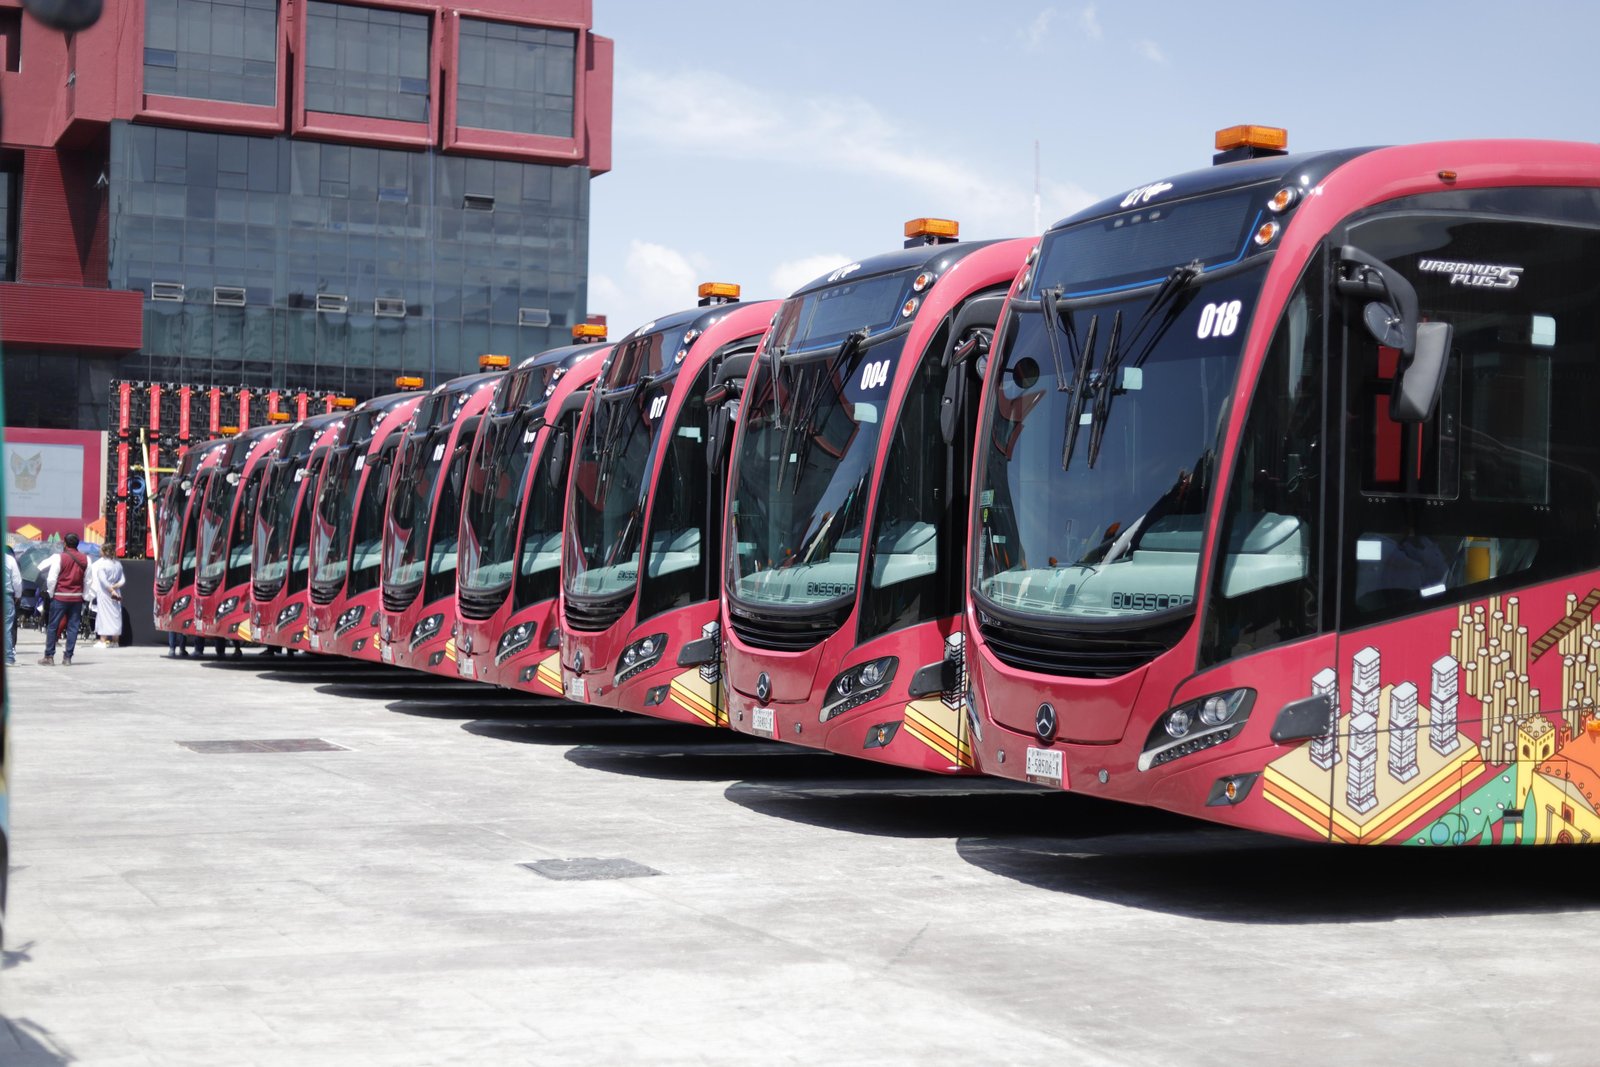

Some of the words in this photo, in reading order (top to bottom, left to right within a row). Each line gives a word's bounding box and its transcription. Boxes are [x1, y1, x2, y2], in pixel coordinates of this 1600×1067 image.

[1197, 300, 1242, 339] 018
[860, 359, 891, 391] 004
[649, 395, 668, 420] 017
